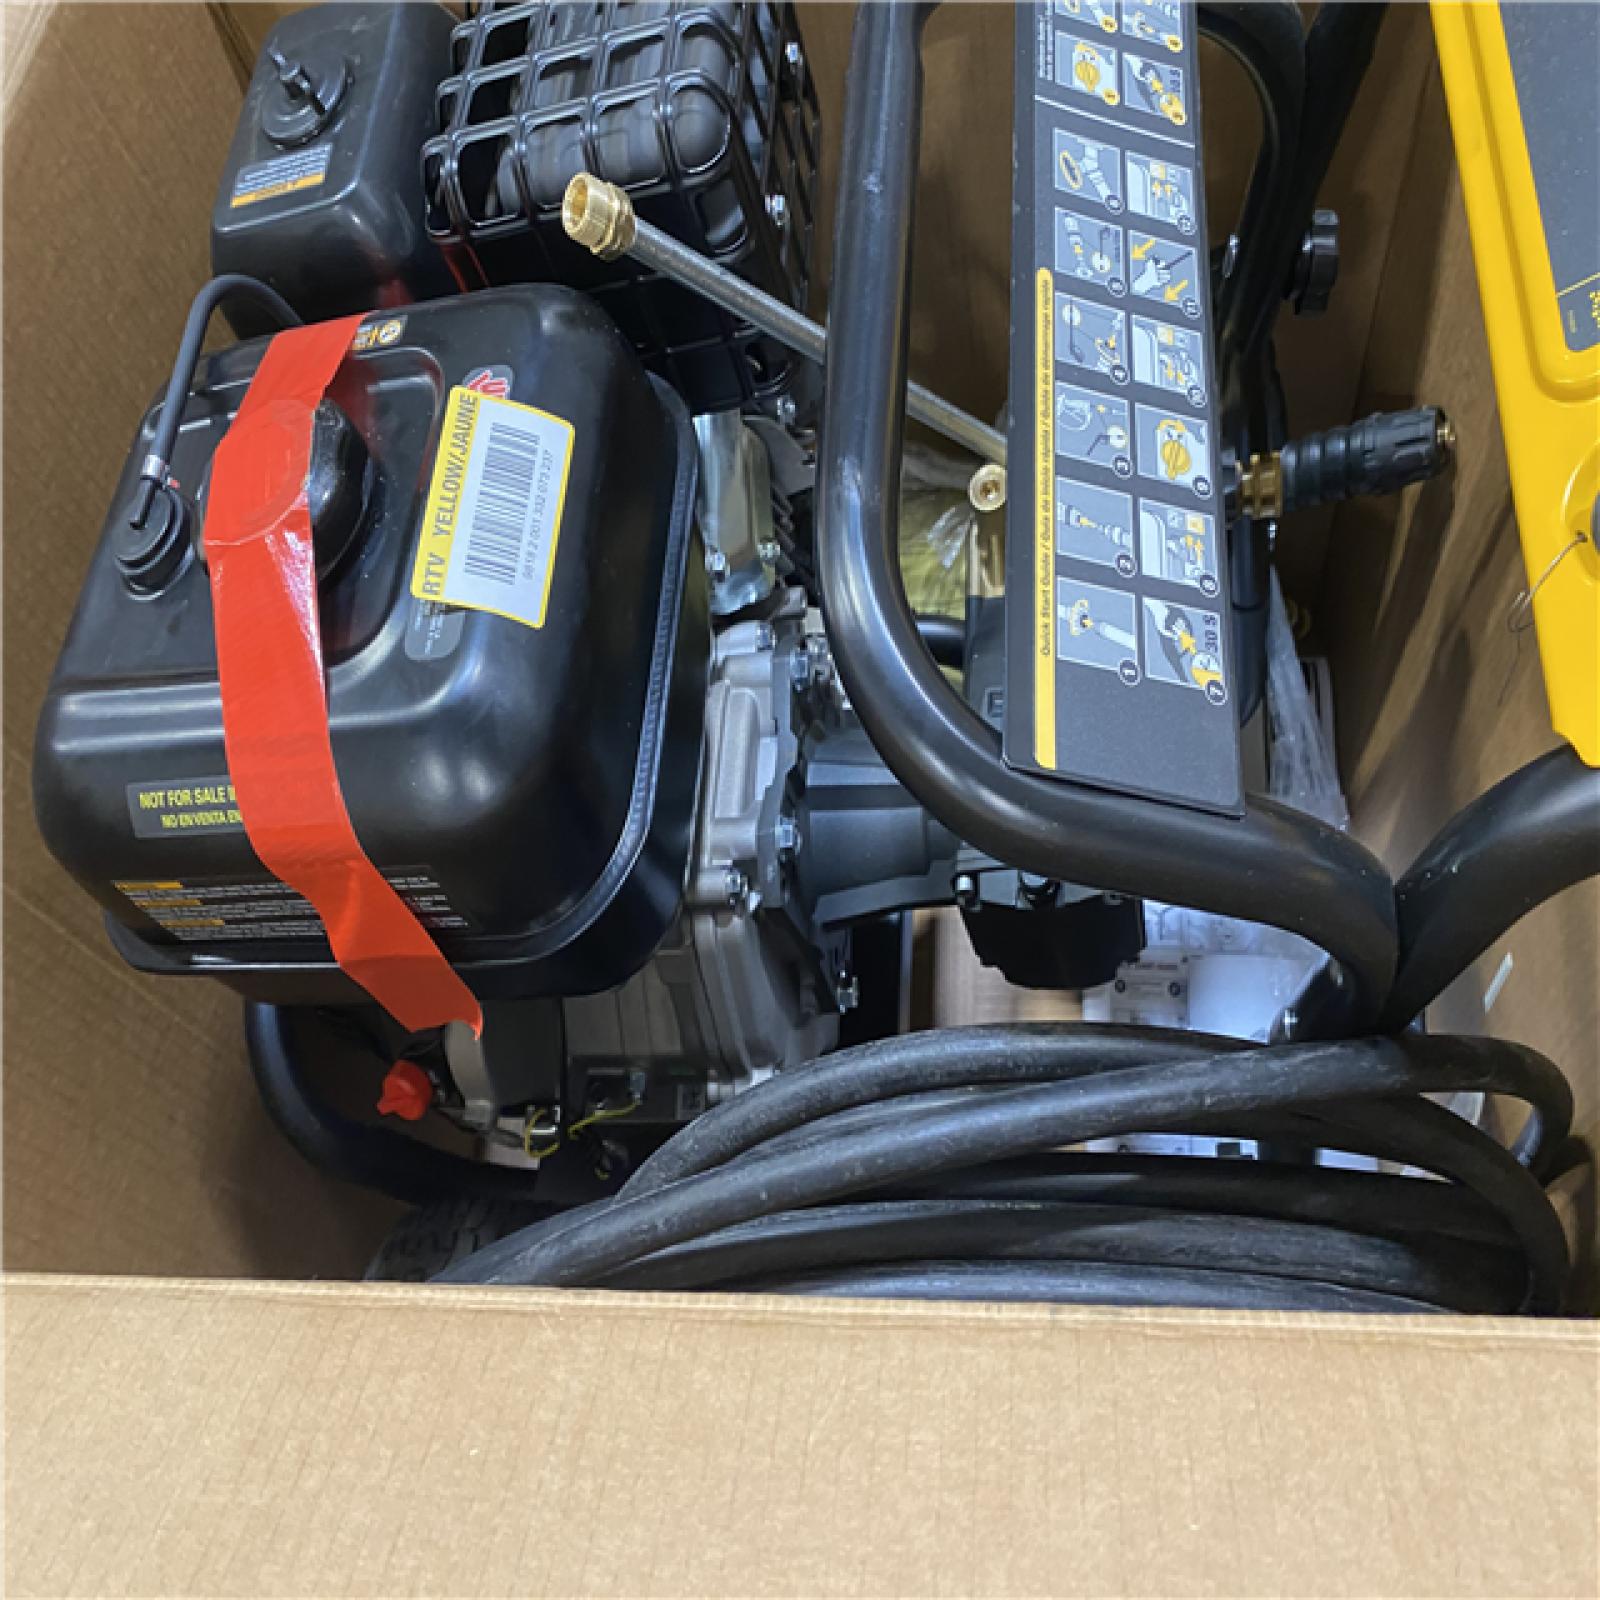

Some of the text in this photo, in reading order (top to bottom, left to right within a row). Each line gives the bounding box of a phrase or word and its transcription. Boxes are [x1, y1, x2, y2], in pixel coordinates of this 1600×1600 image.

[432, 393, 478, 537] YELLOW/JAUNE
[422, 552, 446, 595] RTV
[1040, 552, 1051, 586] Guide
[1040, 589, 1051, 618] Start
[1040, 622, 1051, 656] Quick
[139, 791, 166, 809] NOT
[167, 788, 193, 807] FOR
[194, 785, 227, 805] SALE
[161, 813, 178, 829] NO
